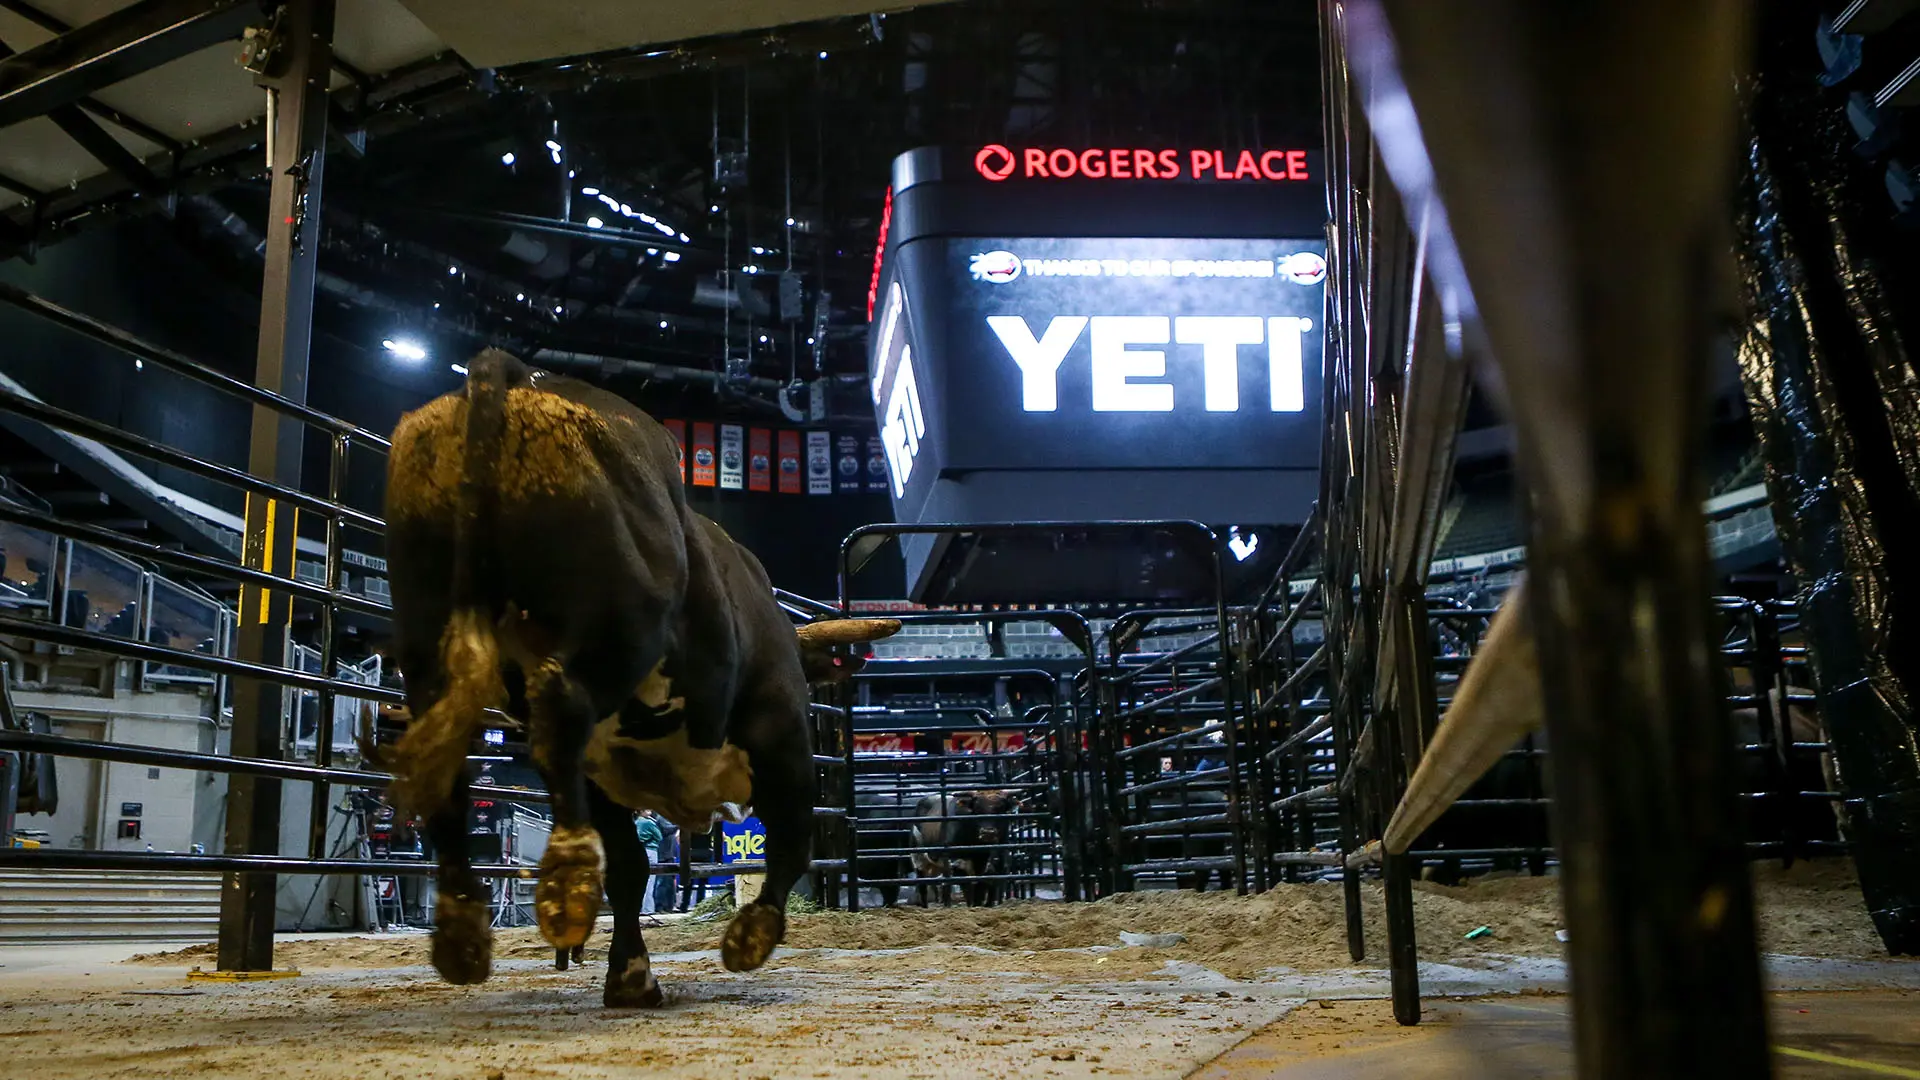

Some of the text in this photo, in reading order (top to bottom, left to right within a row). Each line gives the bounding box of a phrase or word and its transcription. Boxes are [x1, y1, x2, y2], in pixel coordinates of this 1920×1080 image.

[1025, 148, 1309, 180] ROGERS PLACE
[1022, 258, 1100, 277] THANKS
[1100, 259, 1129, 277] TO
[1129, 259, 1171, 277] OUR
[985, 315, 1305, 413] YETI
[722, 829, 766, 860] ngle
